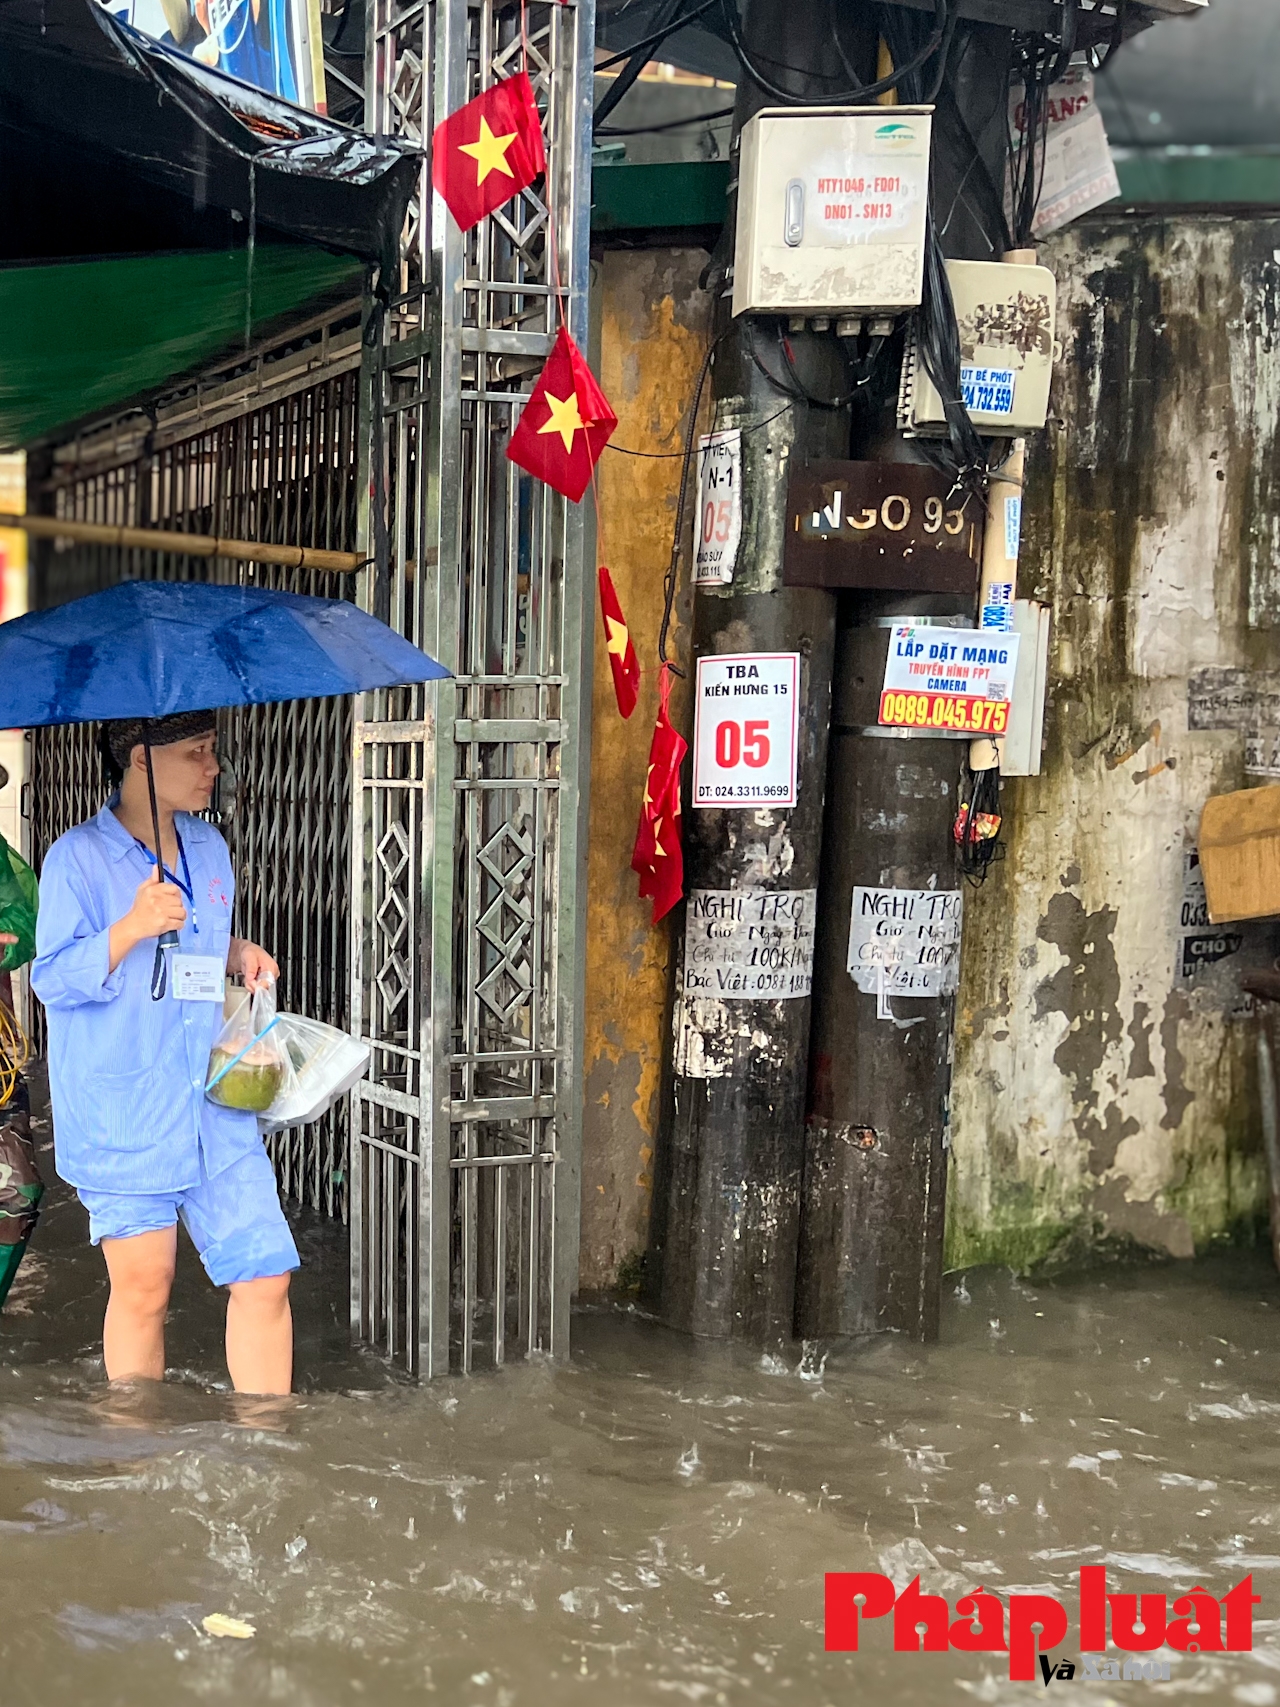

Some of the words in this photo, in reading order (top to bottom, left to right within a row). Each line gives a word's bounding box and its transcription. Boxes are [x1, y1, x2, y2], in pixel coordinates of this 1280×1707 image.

[817, 178, 864, 193] HTY1046
[874, 177, 900, 192] FD01
[825, 205, 852, 219] DN01
[863, 204, 892, 218] SN13
[704, 501, 732, 543] 05
[929, 642, 958, 662] ĐẶT
[962, 647, 1008, 665] MẠNG
[726, 665, 759, 679] TBA
[972, 667, 990, 680] FPT
[705, 682, 730, 697] KIẾN
[773, 684, 788, 695] 15
[927, 678, 967, 692] CAMERA
[882, 693, 1007, 731] 0989.045.975
[715, 720, 770, 768] 05
[715, 785, 789, 797] 024.3311.9699
